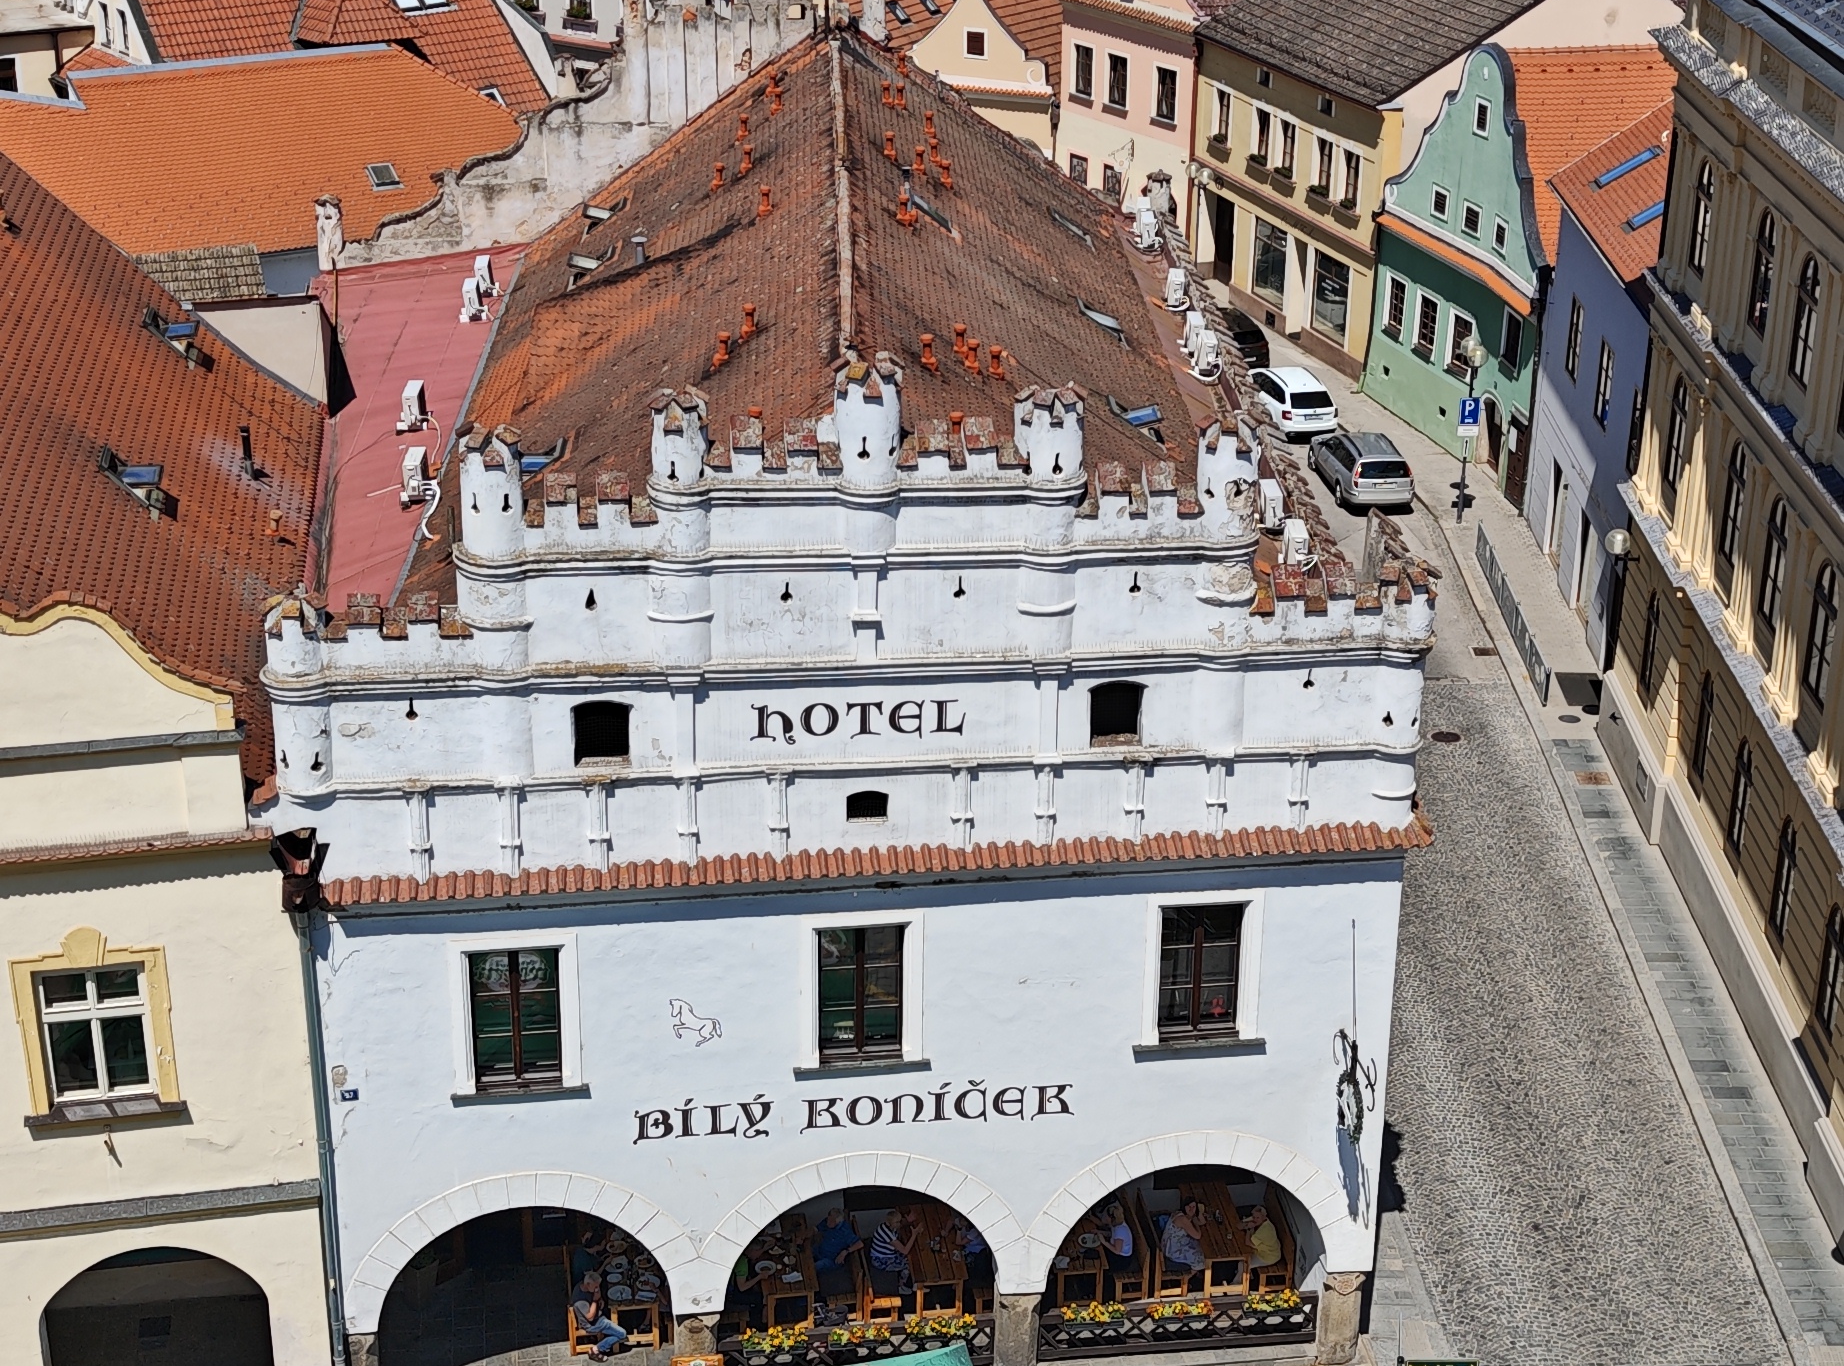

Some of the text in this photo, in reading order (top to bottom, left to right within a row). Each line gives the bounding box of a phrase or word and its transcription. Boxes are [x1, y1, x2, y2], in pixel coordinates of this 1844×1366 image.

[1464, 400, 1475, 416] P
[750, 699, 966, 745] HOTEL
[633, 1079, 1075, 1145] BÍLÝ KONÍČEK
